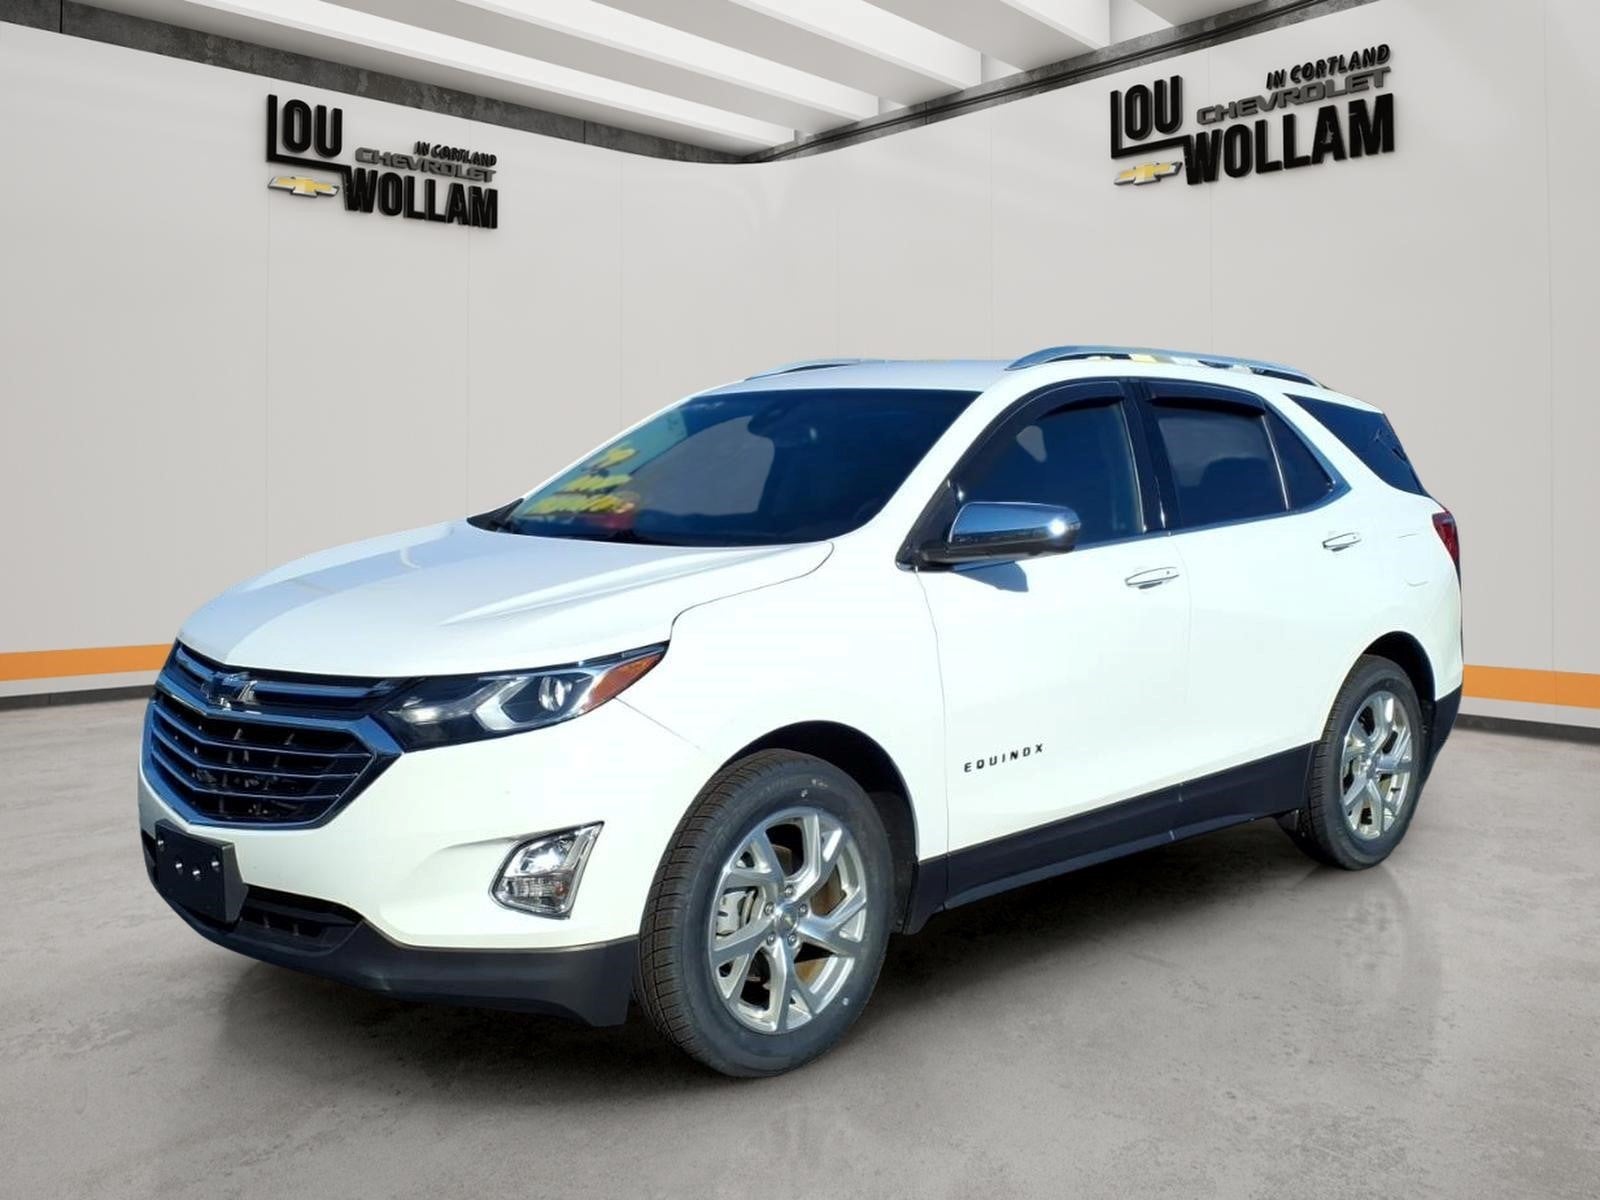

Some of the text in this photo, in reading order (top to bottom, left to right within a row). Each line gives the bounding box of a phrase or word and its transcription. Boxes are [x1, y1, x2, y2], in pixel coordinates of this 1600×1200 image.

[1197, 66, 1391, 125] CHEVROLET
[1266, 44, 1390, 90] IN CORTLAND
[266, 94, 343, 164] LOU
[1110, 75, 1183, 159] LOU
[1183, 93, 1394, 185] WOLLAM
[355, 147, 496, 182] CHEVROLET
[414, 141, 497, 167] IN CORTLAND
[344, 166, 498, 229] WOLLAM
[963, 743, 1043, 773] EQUINOX
